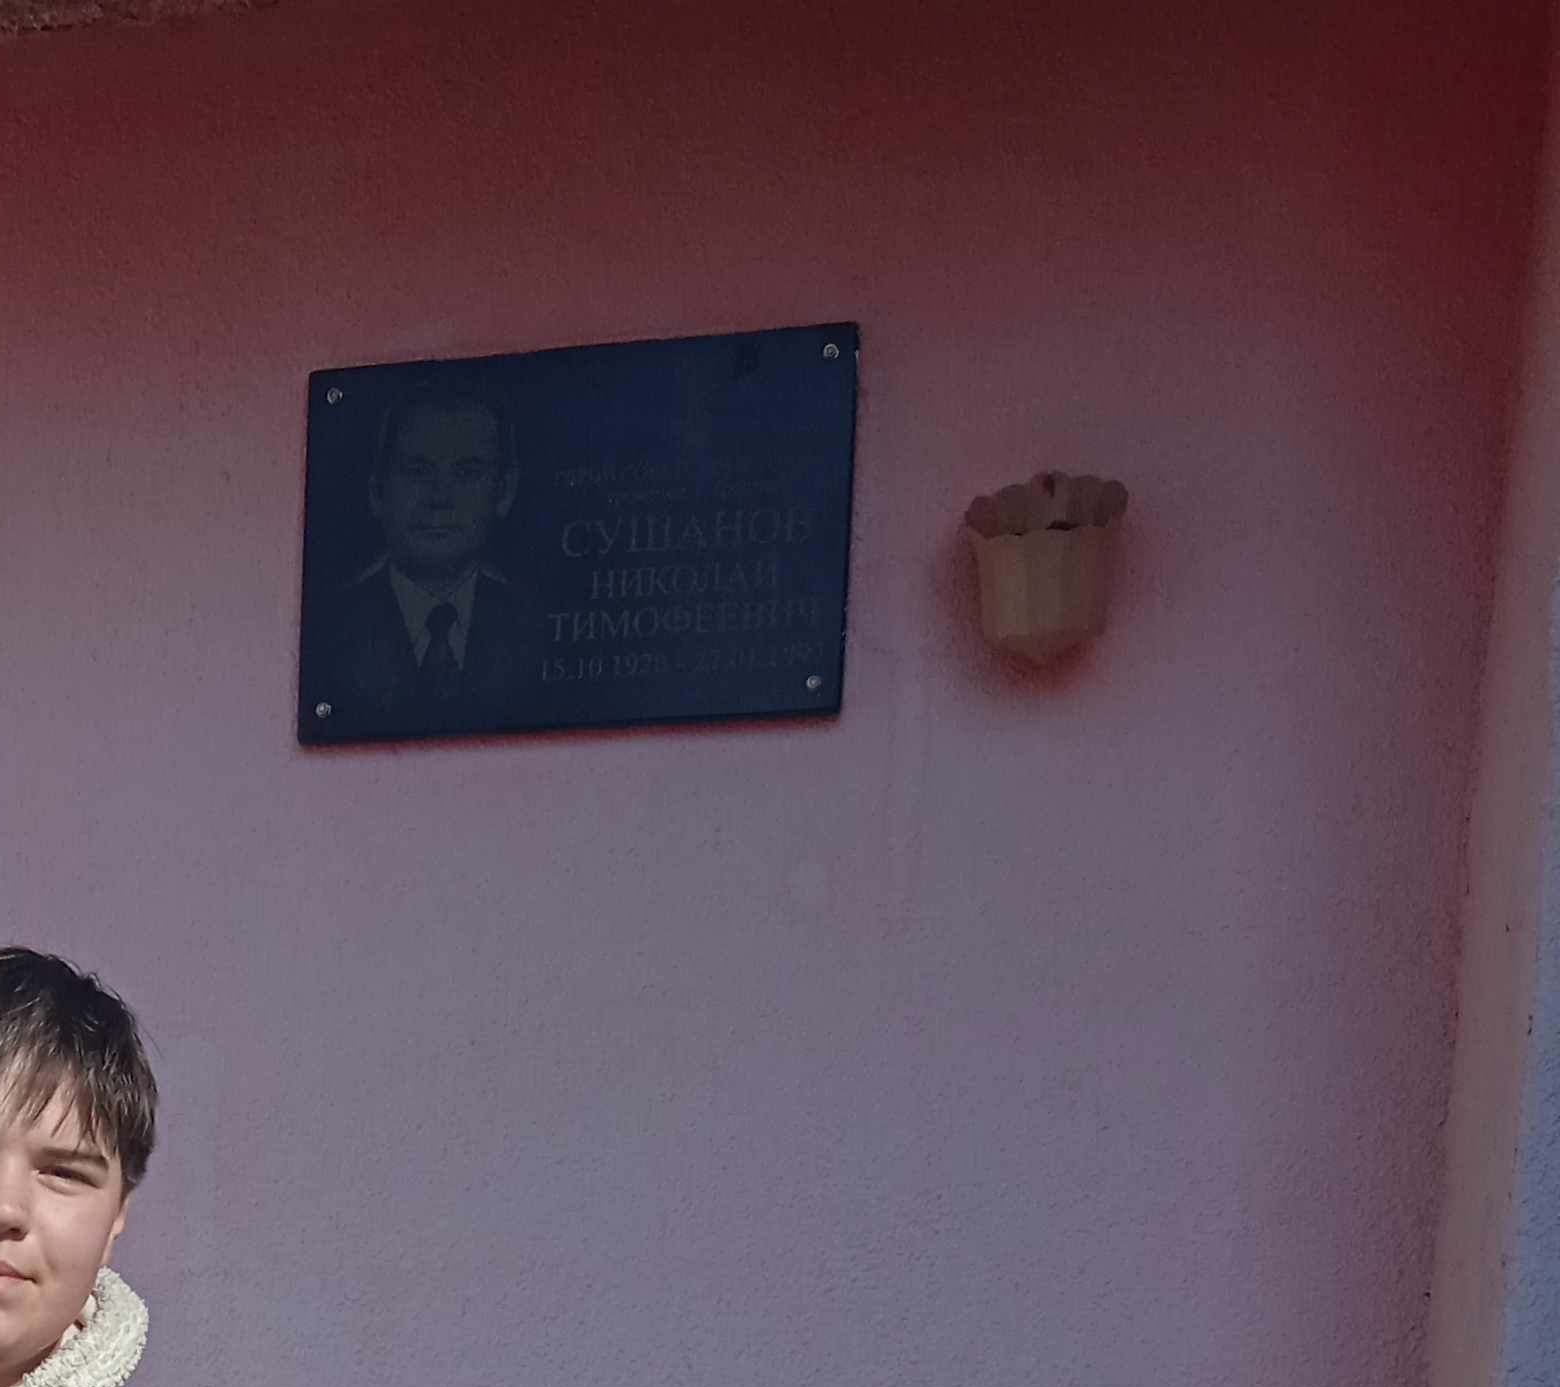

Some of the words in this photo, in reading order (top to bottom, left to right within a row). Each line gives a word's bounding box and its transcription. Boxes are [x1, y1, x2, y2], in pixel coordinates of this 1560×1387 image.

[561, 505, 816, 557] СУШАНОВ
[590, 557, 779, 600] НИКОЛАЙ
[547, 597, 820, 642] ТИМОФЕЕВИЧ
